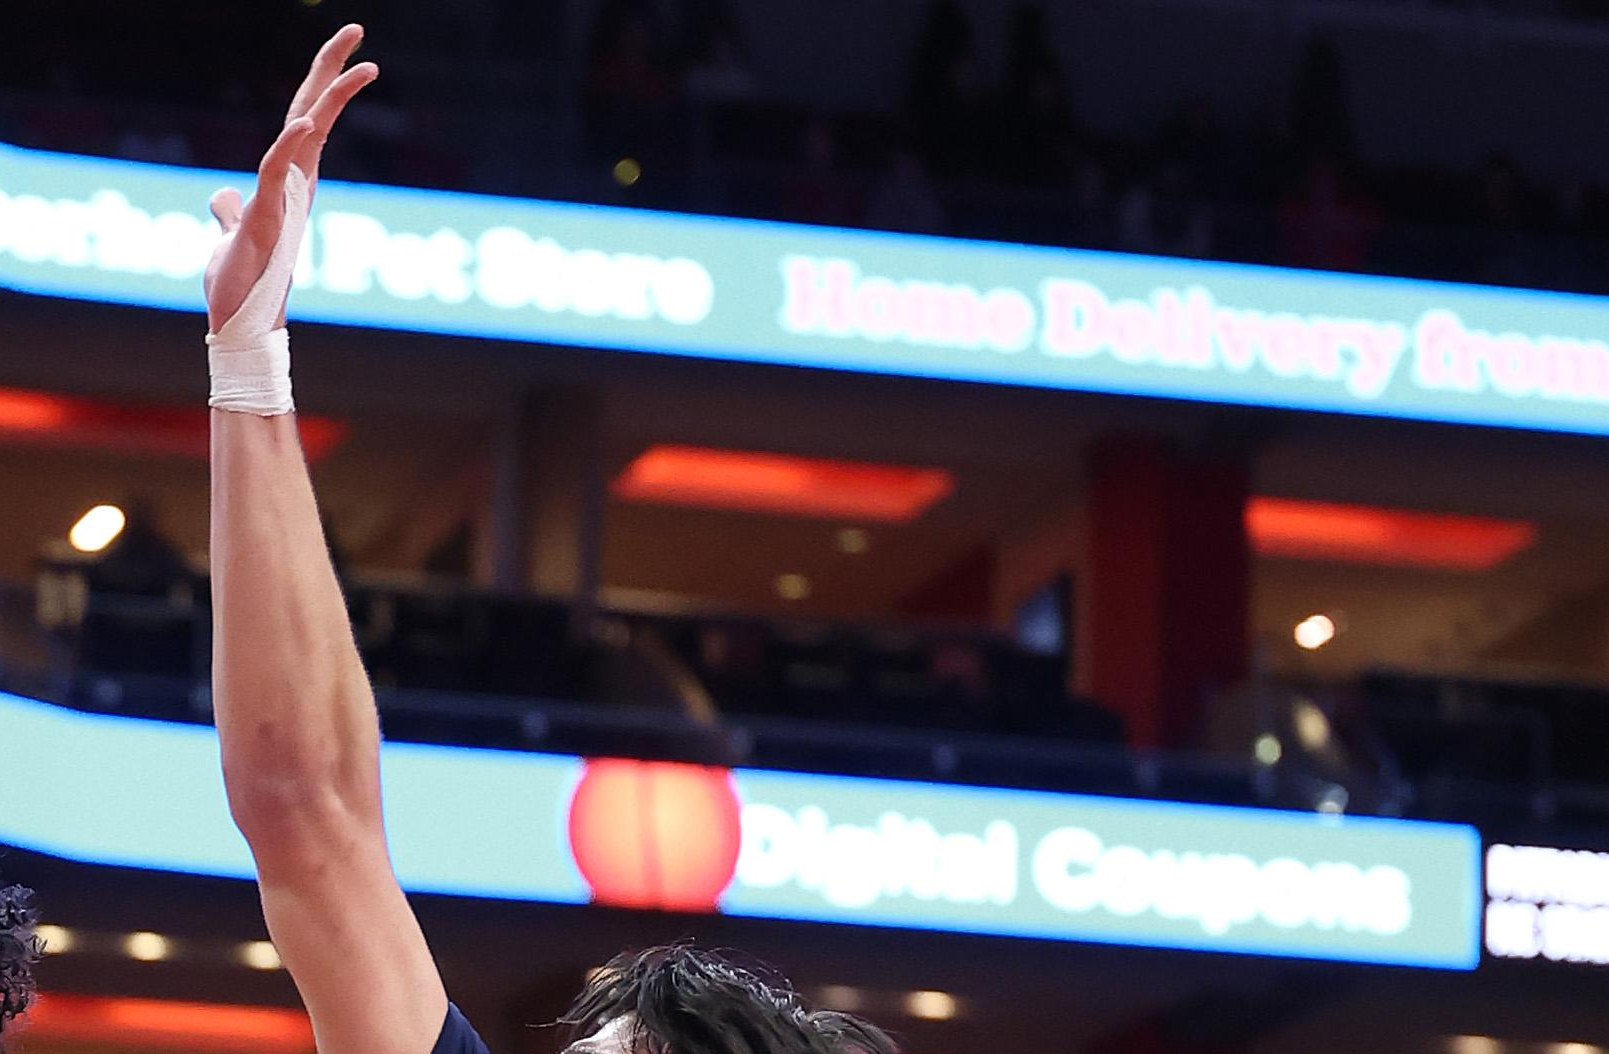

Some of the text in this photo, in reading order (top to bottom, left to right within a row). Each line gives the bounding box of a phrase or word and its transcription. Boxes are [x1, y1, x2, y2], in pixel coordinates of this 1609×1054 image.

[322, 212, 471, 300] Pet
[476, 227, 712, 322] Store
[783, 255, 1032, 351] Home
[1040, 281, 1405, 397] Delivery
[738, 803, 1017, 905] Digital
[1034, 826, 1410, 934] Coupons
